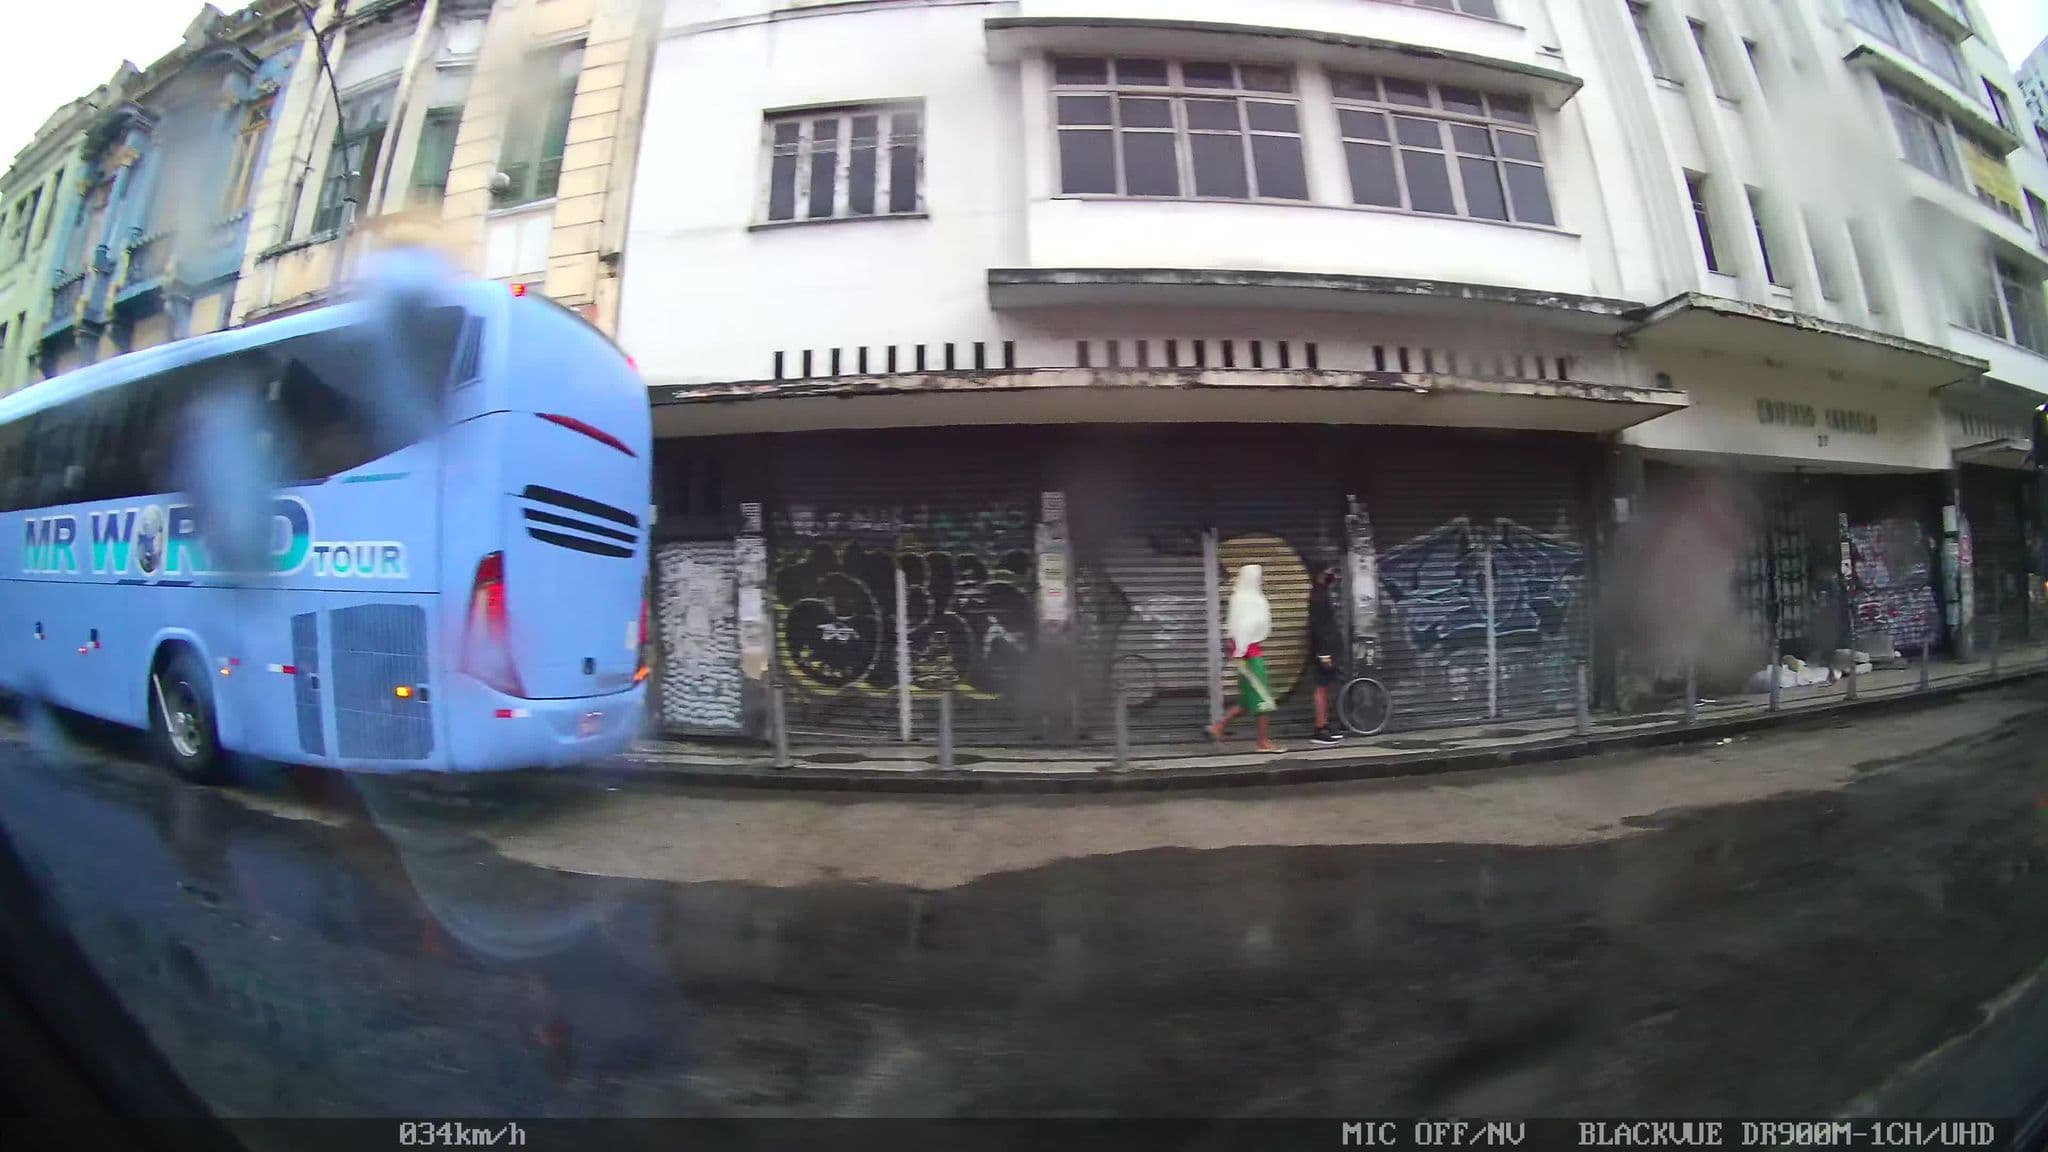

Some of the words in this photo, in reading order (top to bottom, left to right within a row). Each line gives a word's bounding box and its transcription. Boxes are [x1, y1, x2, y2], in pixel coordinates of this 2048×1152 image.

[23, 516, 76, 573] MR
[90, 498, 311, 574] WORD
[313, 544, 404, 575] TOUR
